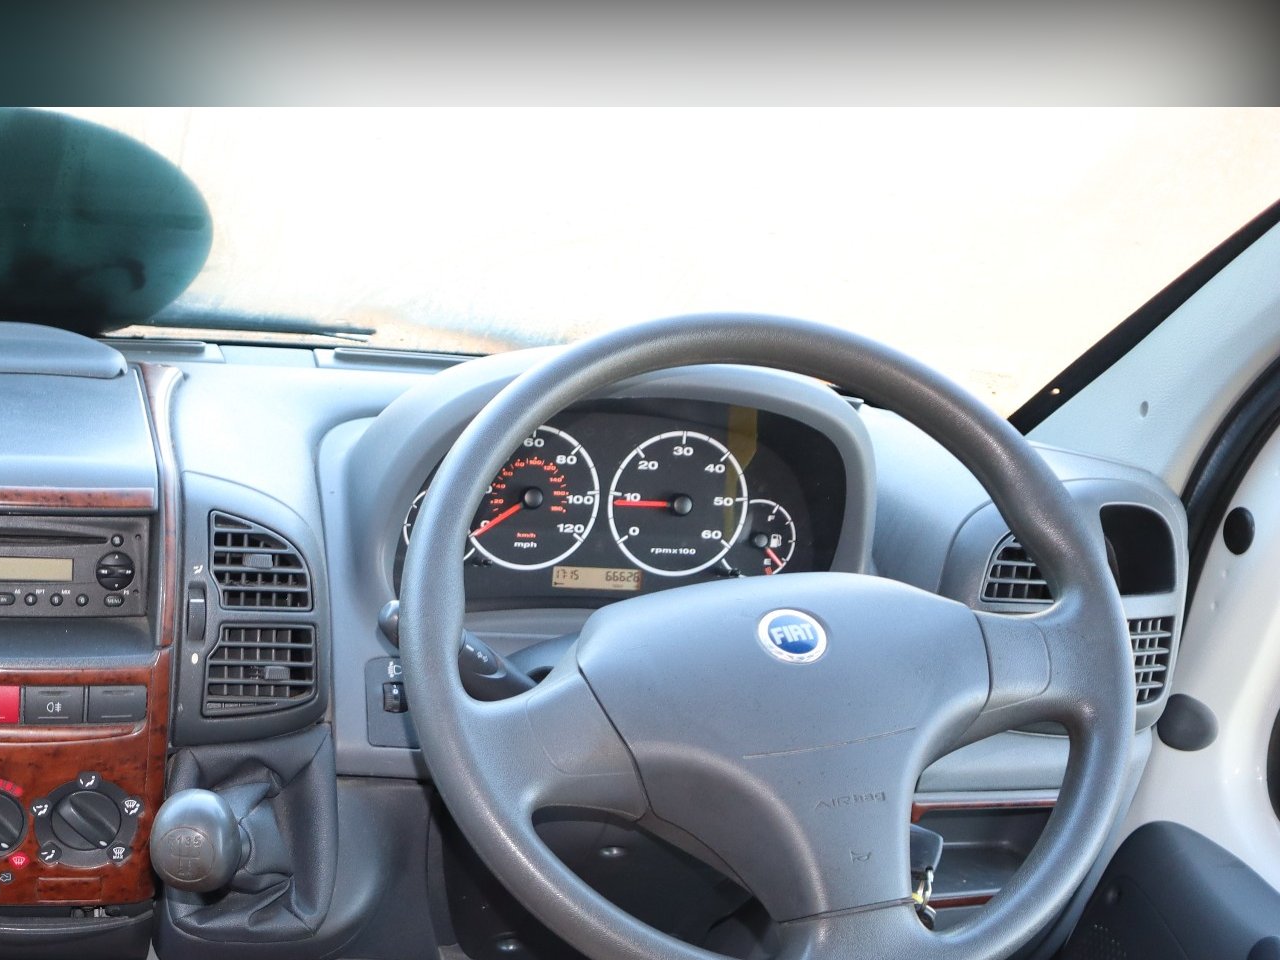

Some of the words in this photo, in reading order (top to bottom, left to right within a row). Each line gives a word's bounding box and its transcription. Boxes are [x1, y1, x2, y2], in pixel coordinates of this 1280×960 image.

[523, 438, 545, 448] 60
[673, 446, 694, 456] 30
[556, 455, 578, 465] 80
[638, 460, 659, 470] 20
[704, 464, 726, 474] 40
[566, 495, 595, 505] 100
[623, 492, 641, 501] 10
[713, 497, 734, 507] 50
[557, 523, 585, 533] 120
[628, 526, 640, 536] 0
[701, 530, 723, 540] 60
[513, 541, 538, 549] mph
[770, 623, 815, 645] FIAT
